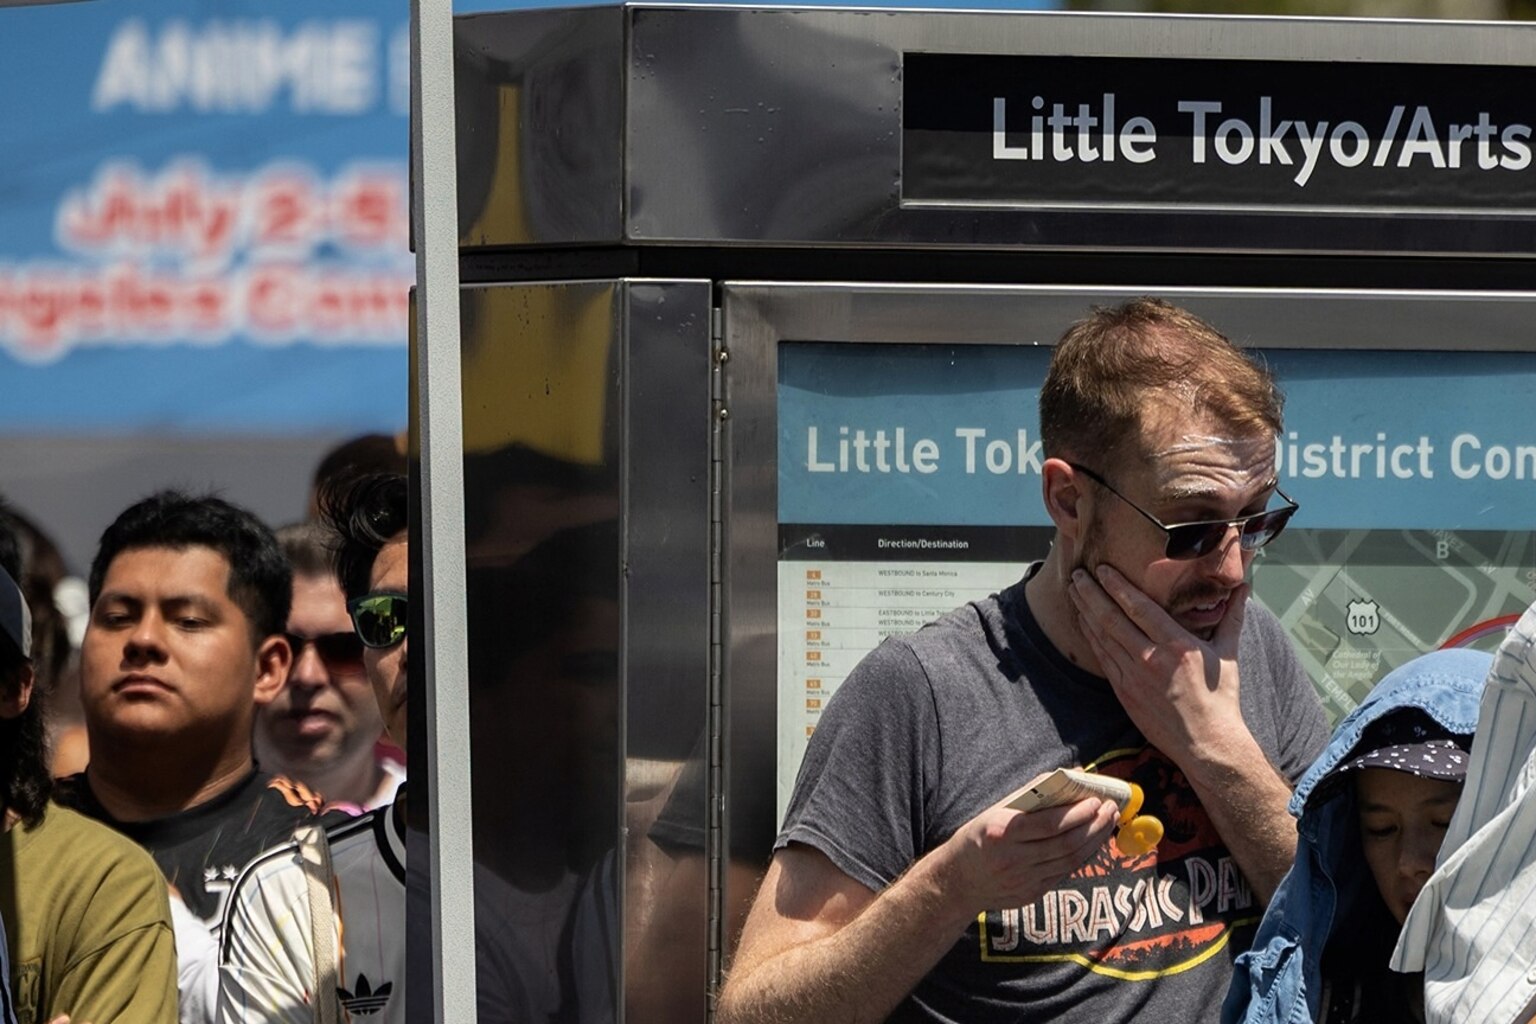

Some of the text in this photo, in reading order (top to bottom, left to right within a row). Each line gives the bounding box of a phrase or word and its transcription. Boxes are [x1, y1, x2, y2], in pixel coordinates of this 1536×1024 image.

[90, 17, 379, 114] ANIME
[993, 94, 1156, 163] Little
[1178, 96, 1533, 187] Tokyo/Arts
[807, 426, 940, 474] Little
[956, 428, 1043, 475] Tok
[806, 538, 969, 550] Line Direction/Destination
[1436, 541, 1450, 559] B
[1352, 615, 1374, 628] 101
[991, 856, 1252, 951] JURASSIC PA
